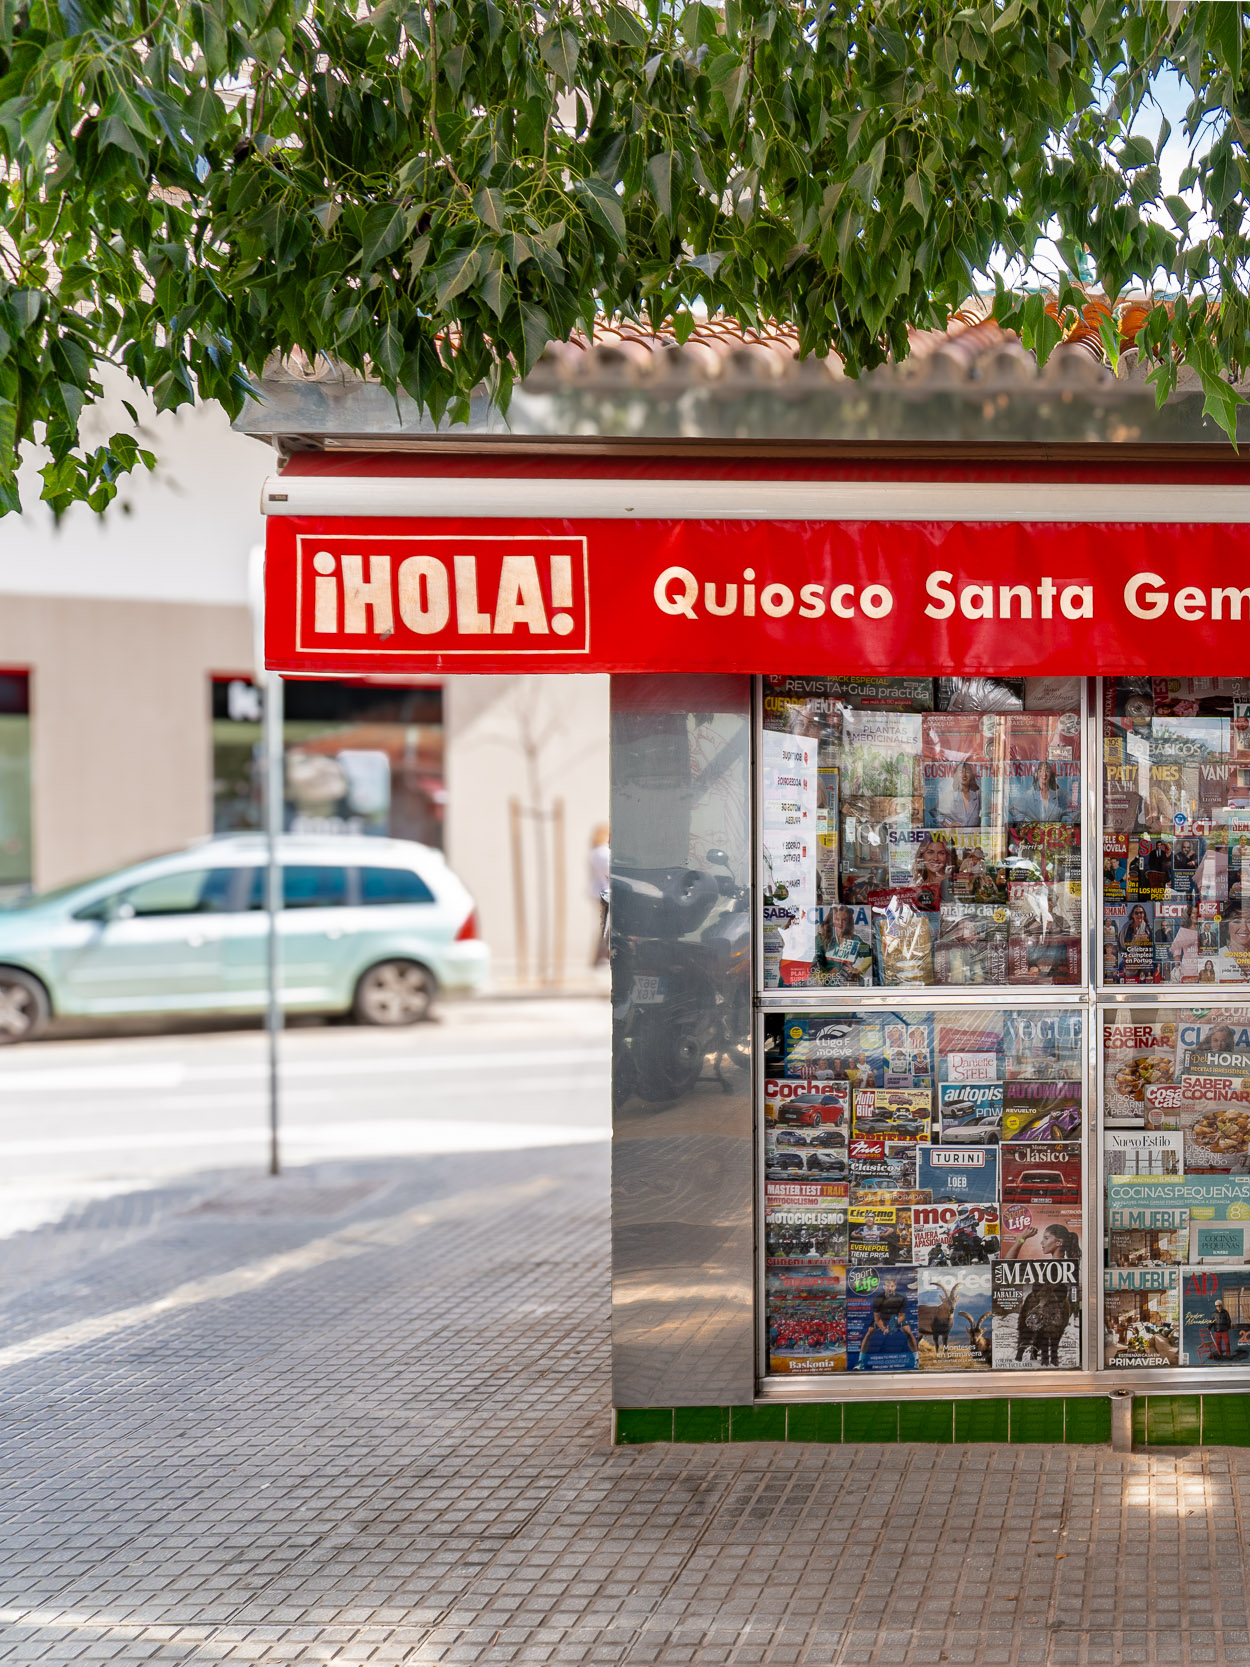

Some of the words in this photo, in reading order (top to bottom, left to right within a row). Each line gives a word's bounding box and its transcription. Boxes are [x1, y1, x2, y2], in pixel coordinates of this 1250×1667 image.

[313, 551, 575, 637] ¡HOLA!
[653, 566, 894, 621] Quiosco
[923, 570, 1094, 620] Santa
[878, 685, 930, 700] práctica
[864, 725, 907, 736] PLANTAS
[1199, 902, 1218, 911] DIEZ
[1211, 1015, 1238, 1023] DESDE
[1103, 1025, 1153, 1038] SABER
[822, 1038, 842, 1048] Liga
[844, 1038, 850, 1046] F
[1103, 1036, 1172, 1049] COCINAR
[952, 1055, 994, 1067] Danielle
[1191, 1054, 1207, 1064] Del
[954, 1068, 992, 1080] STEEL
[765, 1079, 848, 1099] Coches
[1182, 1077, 1233, 1090] SABER
[855, 1091, 875, 1105] Auto
[1181, 1088, 1250, 1101] COCINAR
[855, 1105, 874, 1118] Bild
[1112, 1135, 1142, 1147] Nuevo
[1143, 1135, 1171, 1147] Estilo
[935, 1153, 981, 1163] TURINI
[1014, 1149, 1069, 1163] Clásico
[1186, 1158, 1228, 1166] PESCADO
[850, 1162, 901, 1172] Clásicos
[948, 1177, 967, 1187] LOEB
[767, 1184, 800, 1195] MASTER
[801, 1185, 821, 1196] TEST
[823, 1186, 846, 1196] TRAIL
[1111, 1186, 1174, 1199] COCINAS
[1175, 1183, 1250, 1199] PEQUEÑAS
[767, 1196, 819, 1206] MOTOCICLISMO
[765, 1212, 845, 1225] MOTOCICLISMO
[850, 1208, 894, 1218] Ciclismo
[1002, 1208, 1026, 1220] Sport
[1008, 1216, 1031, 1230] Life
[1111, 1211, 1125, 1230] EL
[1129, 1210, 1188, 1230] MUEBLE
[914, 1231, 939, 1242] VIAJERA
[850, 1243, 889, 1252] EVENEPOEL
[870, 1251, 890, 1259] PRISA
[850, 1267, 873, 1281] Sport
[994, 1265, 1003, 1283] CAZA
[1001, 1261, 1077, 1285] MAYOR
[855, 1275, 879, 1292] Life
[1104, 1271, 1113, 1290] EL
[1118, 1270, 1177, 1291] MUEBLE
[1185, 1271, 1218, 1296] AD
[789, 1359, 835, 1369] Baskonia
[1108, 1357, 1171, 1367] PRIMAVERA
